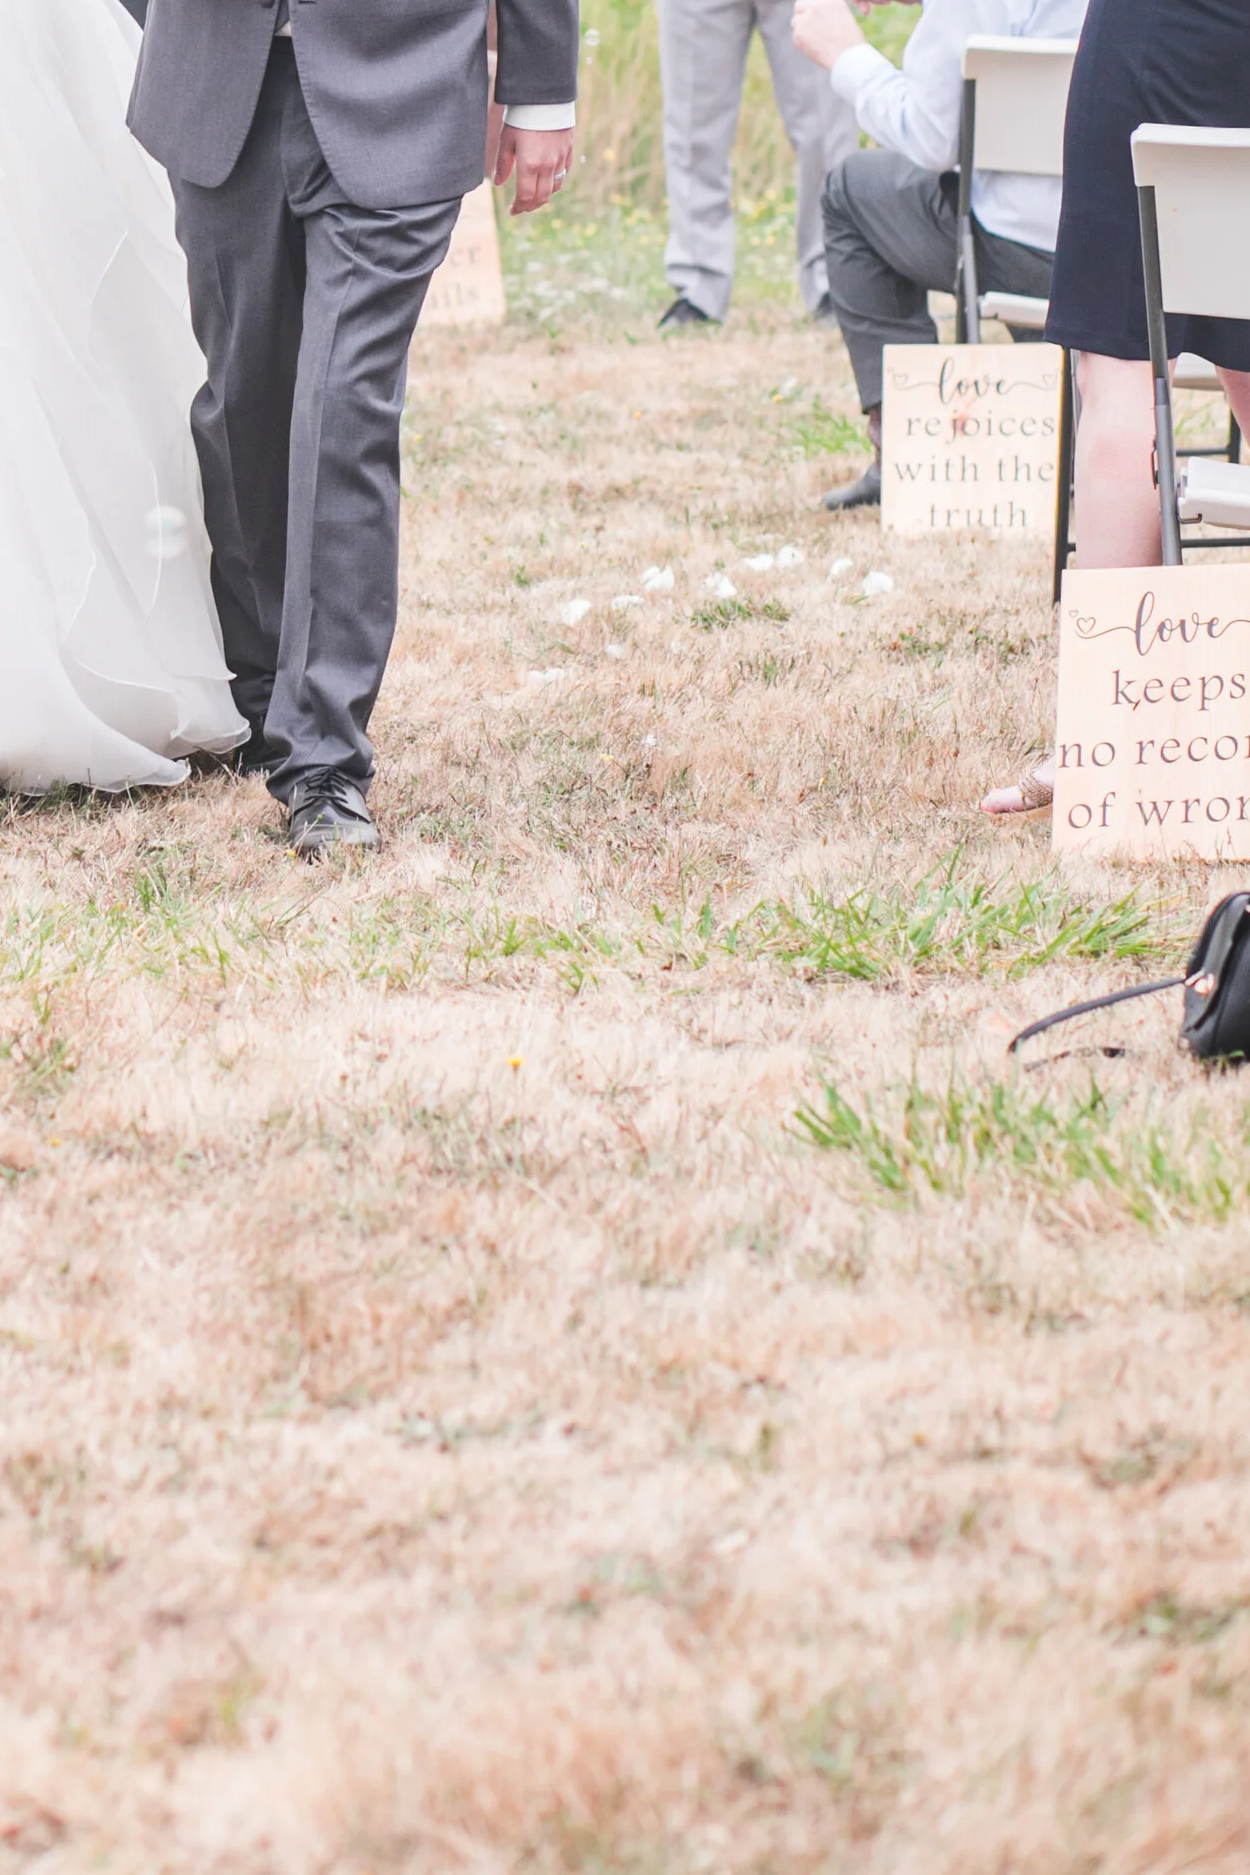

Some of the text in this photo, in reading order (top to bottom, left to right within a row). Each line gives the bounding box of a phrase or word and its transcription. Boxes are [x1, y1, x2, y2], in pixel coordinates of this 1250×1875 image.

[938, 356, 1009, 406] love
[905, 409, 1055, 445] rejoices
[895, 456, 1055, 483] with the
[930, 501, 1027, 528] truth
[1134, 591, 1222, 657] love
[1111, 669, 1247, 712] keeps
[1058, 733, 1250, 768] no reco
[1068, 791, 1116, 829] of
